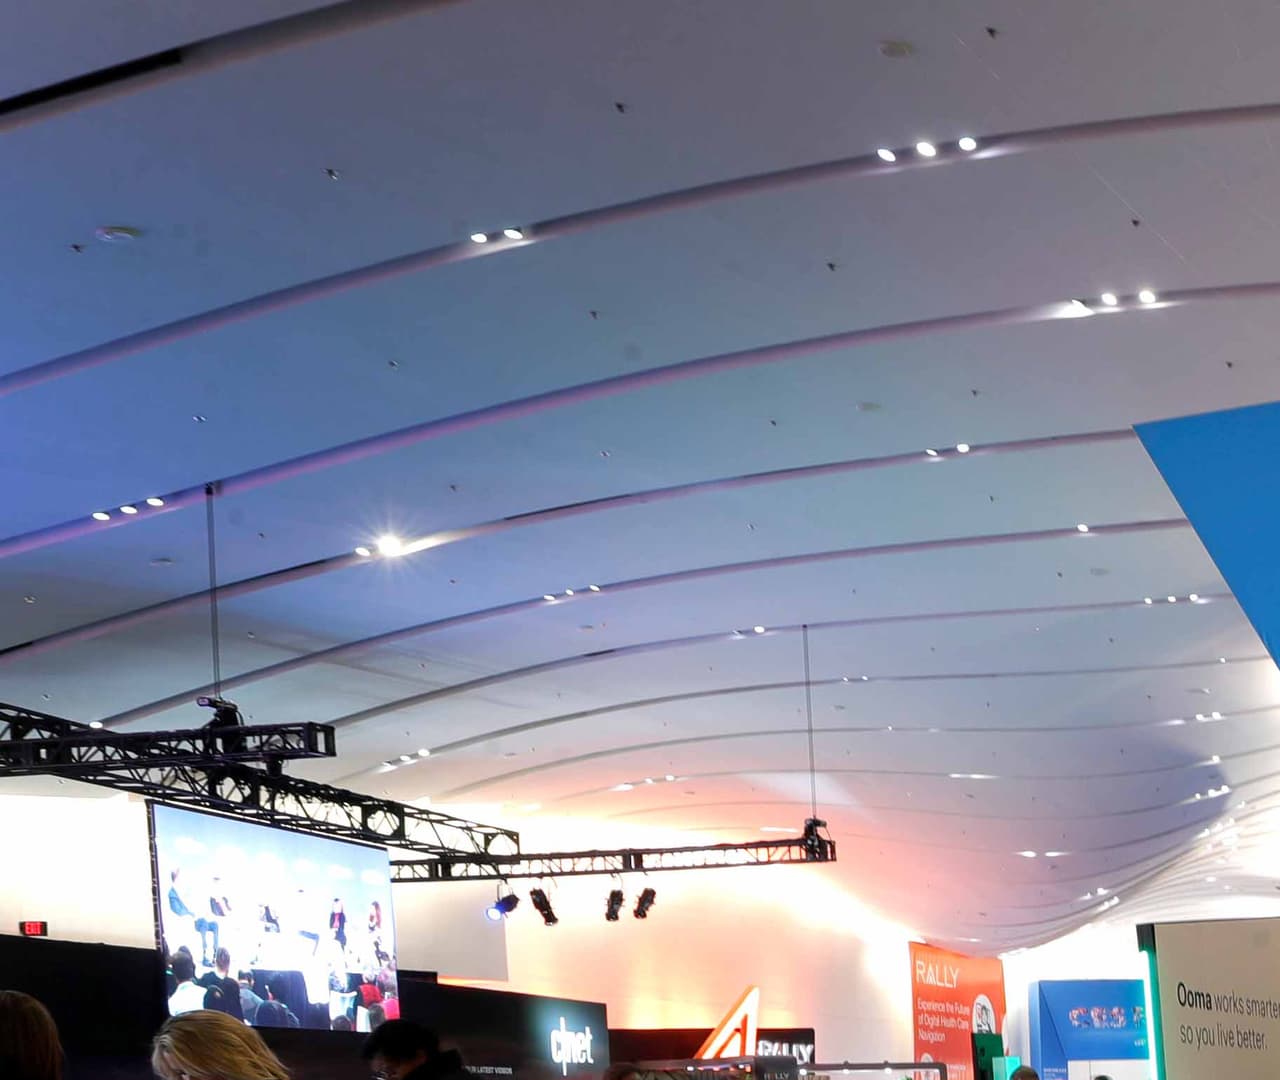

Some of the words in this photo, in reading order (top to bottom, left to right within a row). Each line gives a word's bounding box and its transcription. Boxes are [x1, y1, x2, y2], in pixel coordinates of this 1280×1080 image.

[915, 960, 960, 988] RALLY
[1177, 982, 1212, 1010] Ooma
[1214, 989, 1244, 1015] works
[1180, 1024, 1193, 1044] so
[1195, 1026, 1215, 1051] you
[1217, 1023, 1235, 1047] live
[1236, 1024, 1268, 1050] better.
